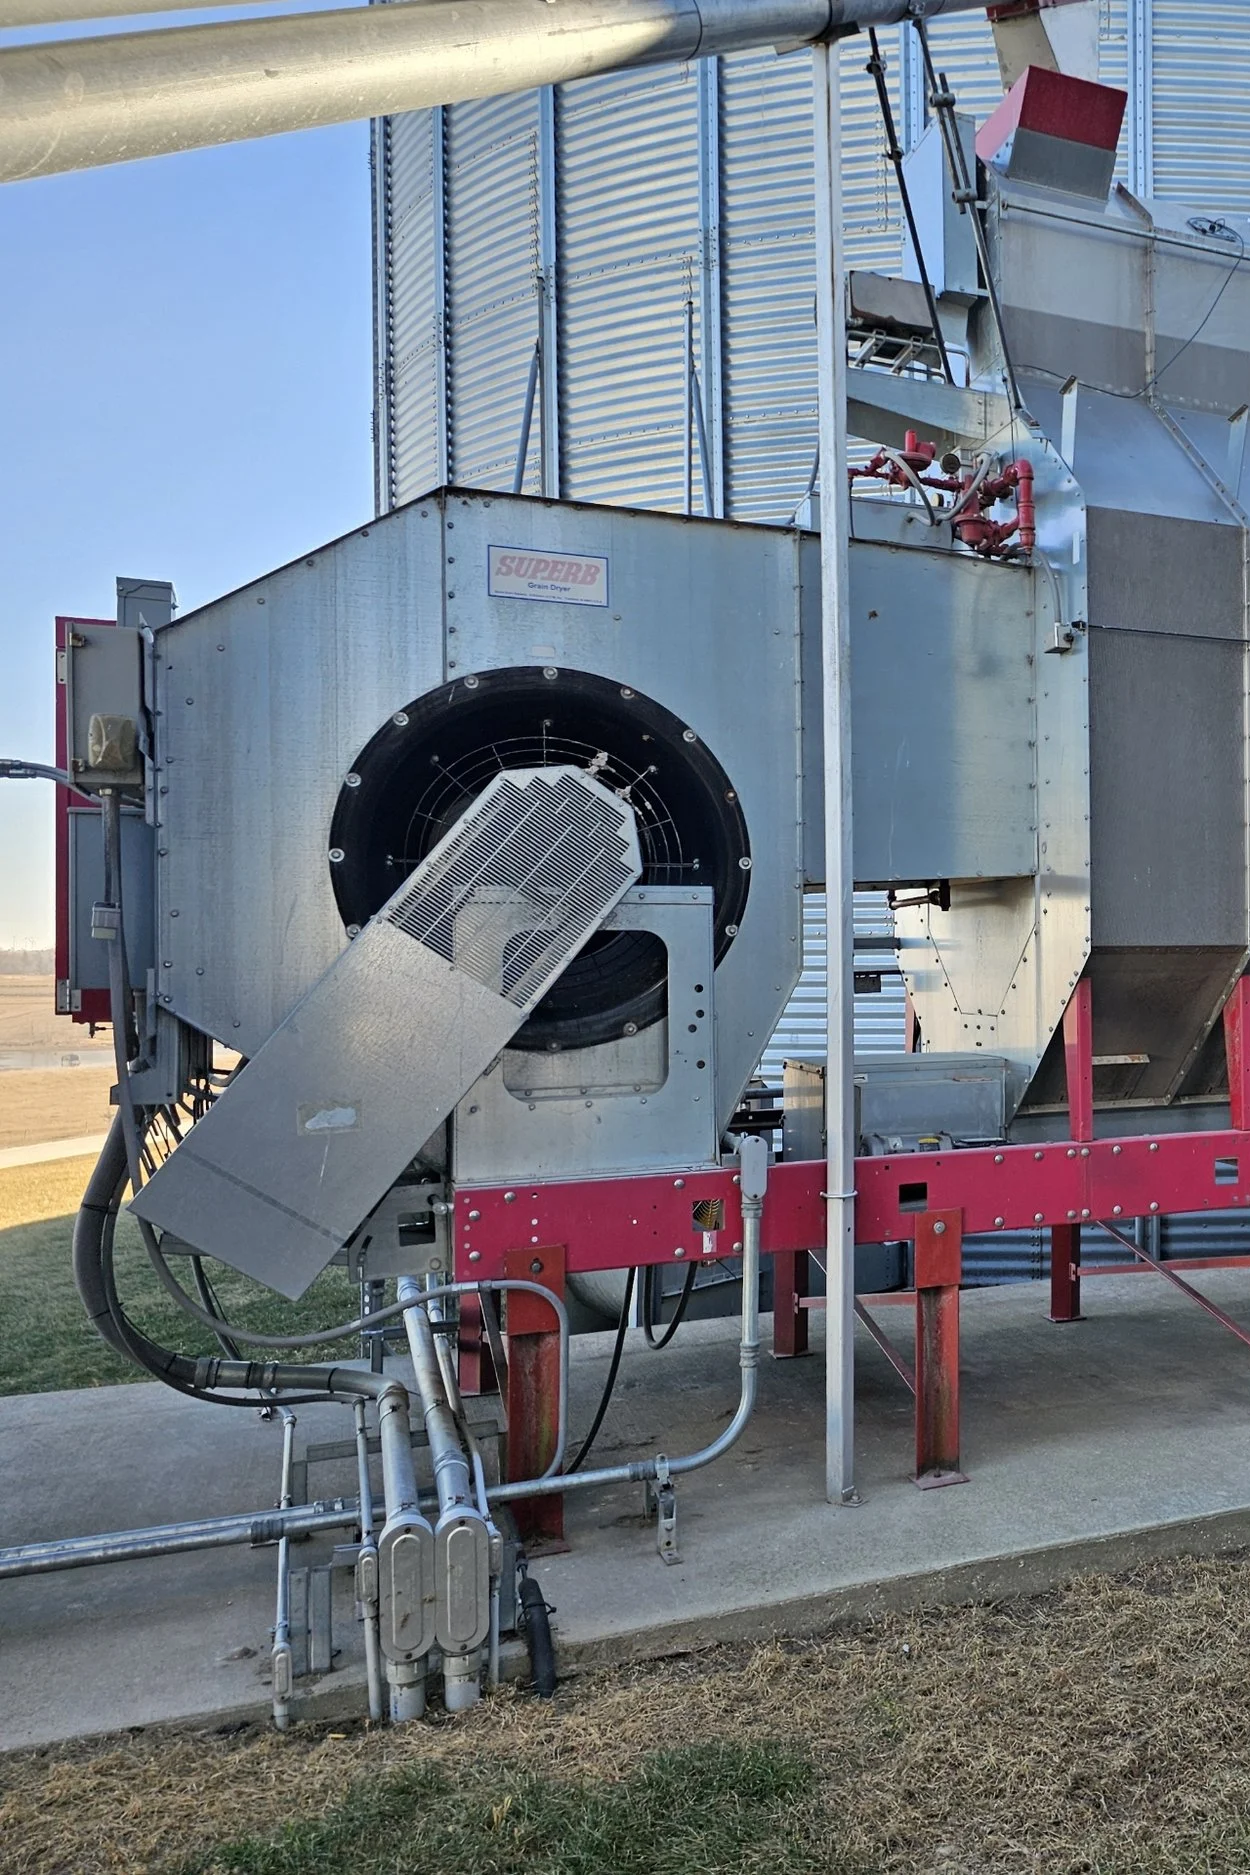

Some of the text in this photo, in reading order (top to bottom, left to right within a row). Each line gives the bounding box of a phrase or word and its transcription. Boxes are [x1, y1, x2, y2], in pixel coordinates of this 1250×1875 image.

[495, 555, 600, 585] SUPERB
[528, 582, 571, 592] Grain Dryer
